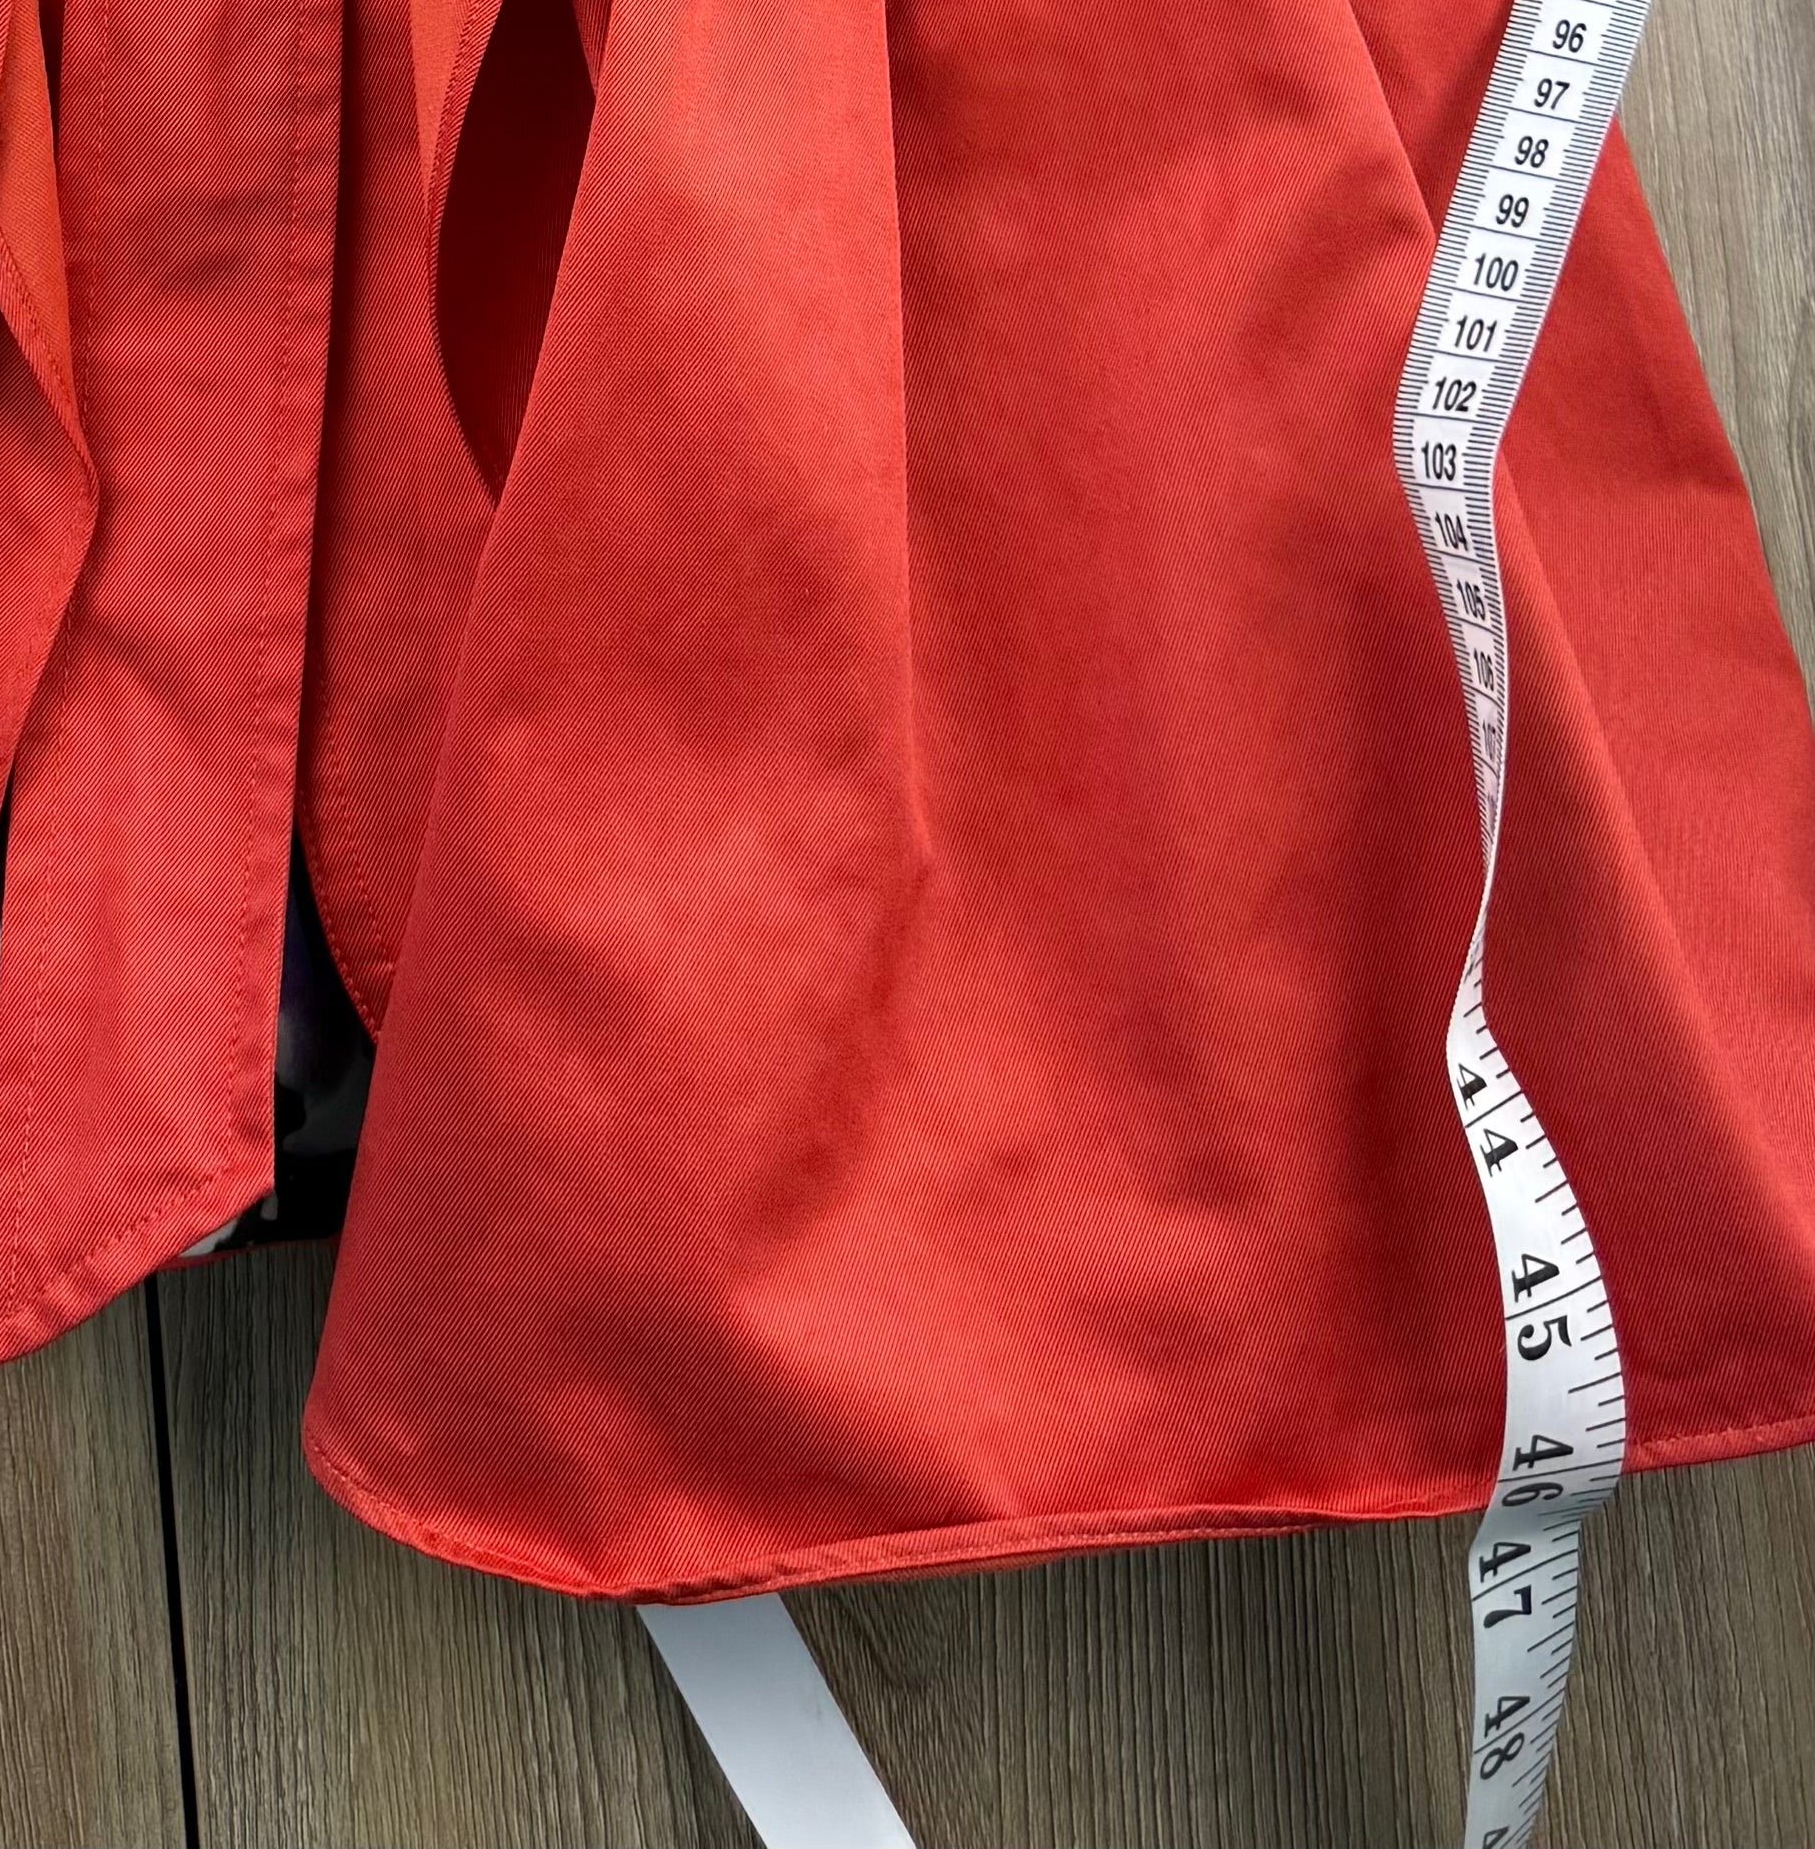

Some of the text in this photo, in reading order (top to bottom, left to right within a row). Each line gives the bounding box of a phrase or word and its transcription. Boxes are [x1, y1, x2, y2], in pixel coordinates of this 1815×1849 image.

[1552, 19, 1587, 54] 96
[1534, 78, 1571, 110] 97
[1514, 135, 1550, 169] 98
[1495, 193, 1530, 229] 99
[1473, 253, 1519, 292] 100
[1454, 315, 1498, 353] 101
[1432, 376, 1477, 413] 102
[1421, 441, 1457, 482] 103
[1434, 512, 1469, 552] 104
[1456, 579, 1486, 622] 105
[1458, 1063, 1519, 1177] 44
[1511, 1253, 1572, 1362] 45
[1501, 1434, 1574, 1508] 46
[1478, 1541, 1533, 1629] 47
[1479, 1696, 1531, 1781] 48
